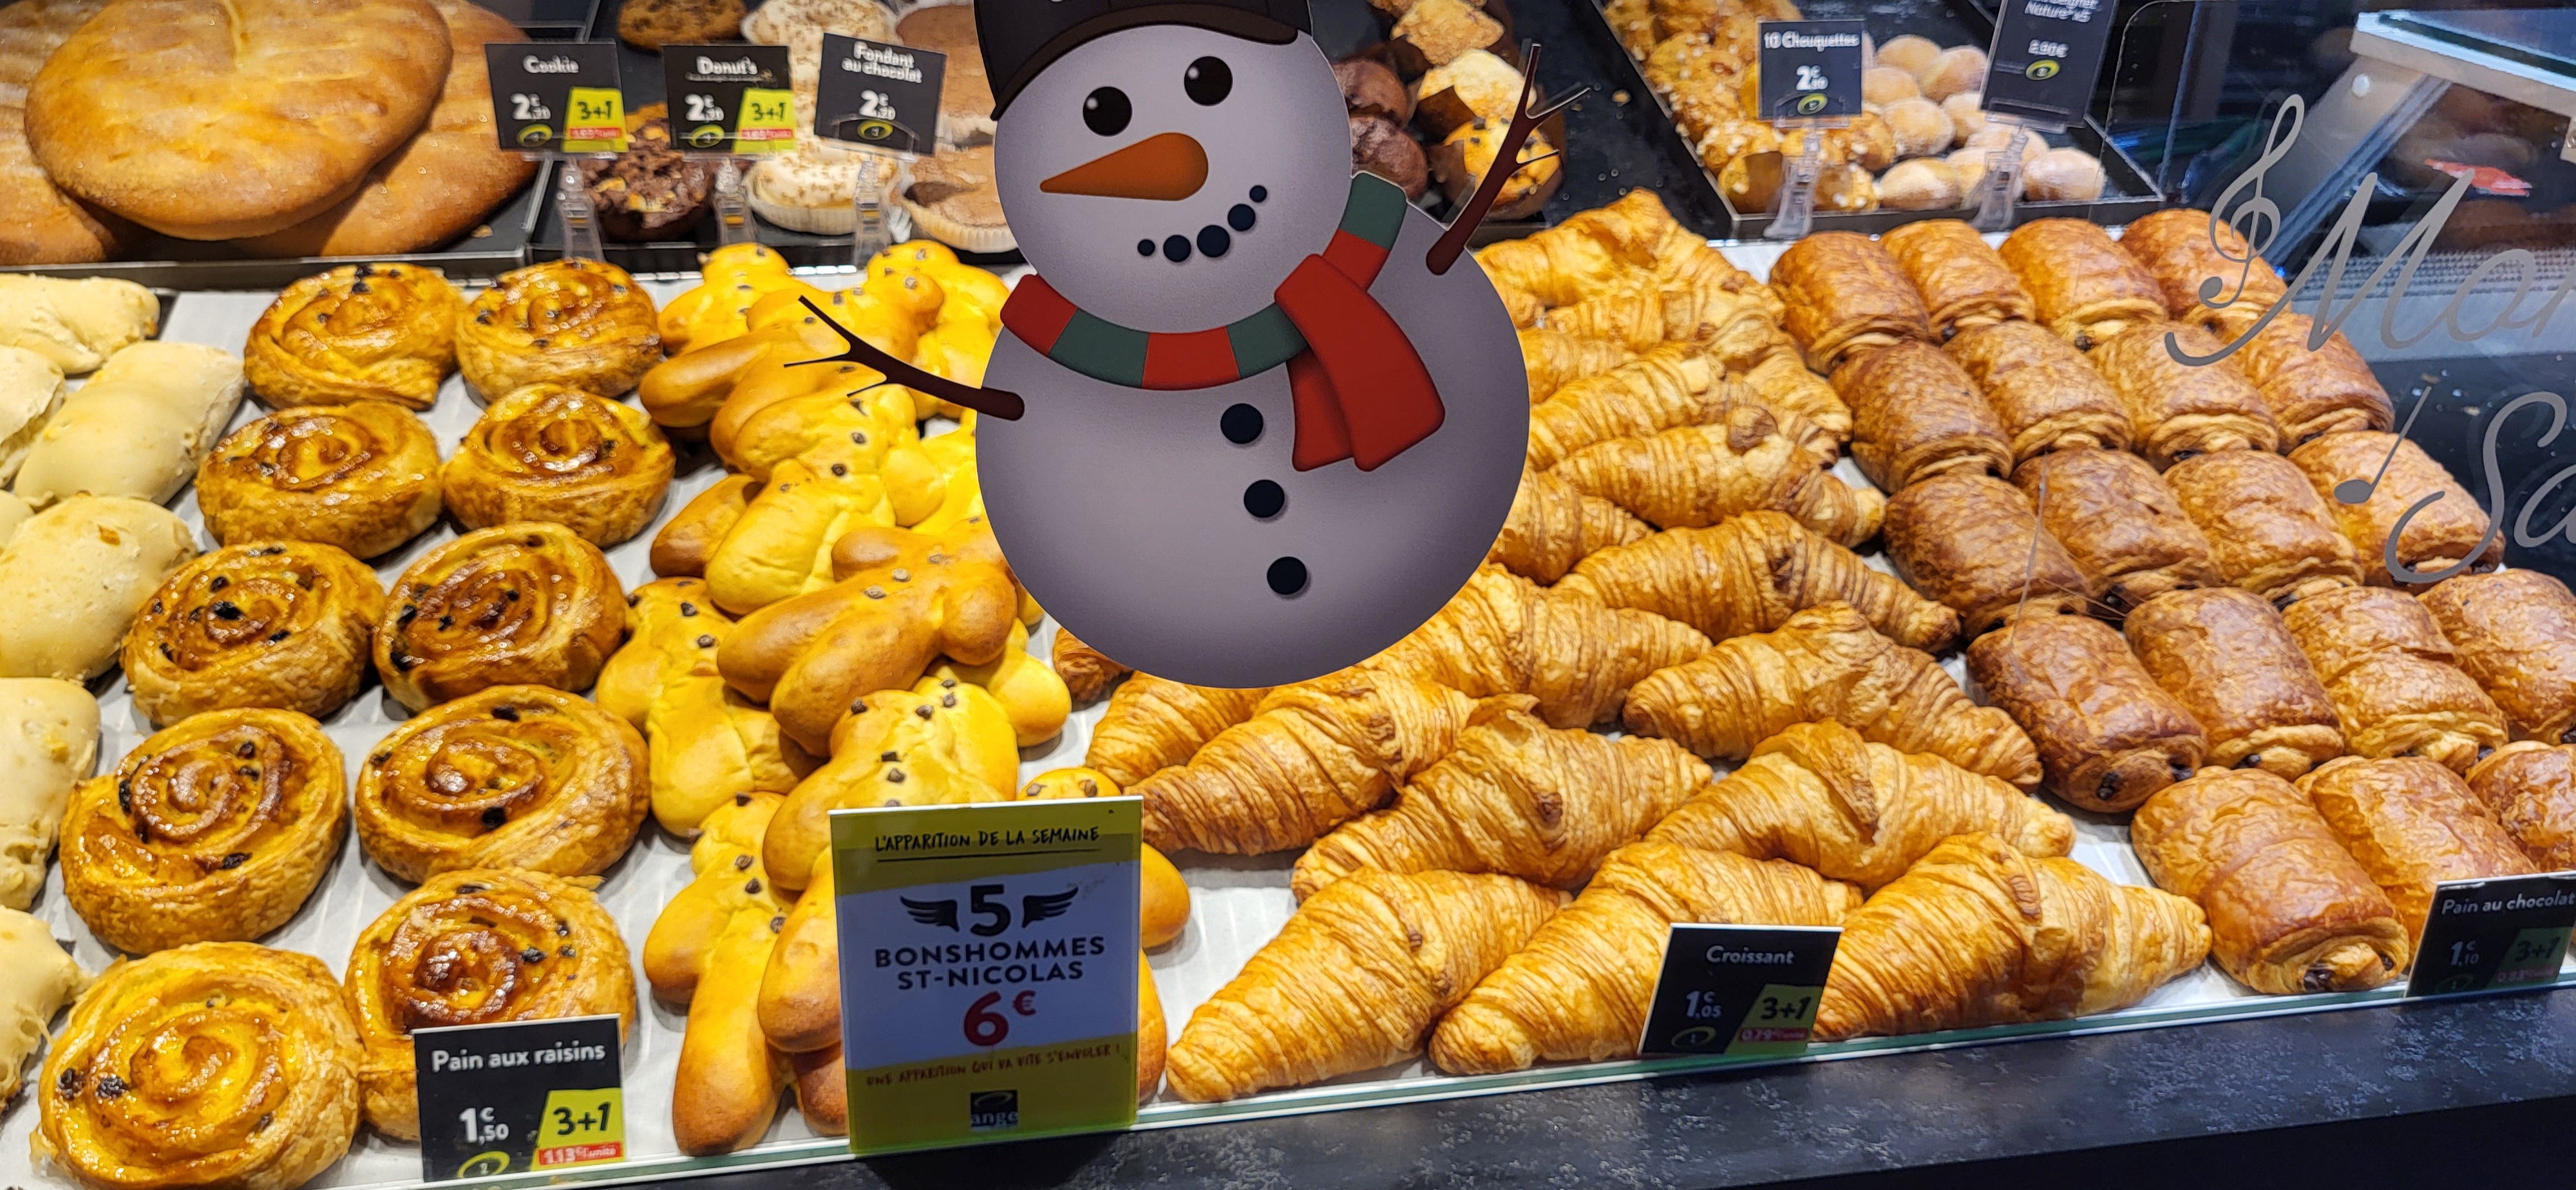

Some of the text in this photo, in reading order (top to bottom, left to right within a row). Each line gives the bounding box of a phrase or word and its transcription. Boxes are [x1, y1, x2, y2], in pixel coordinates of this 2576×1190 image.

[2025, 1, 2070, 20] Nature
[853, 41, 914, 68] Fondant
[1764, 31, 1860, 52] 10 Chouquettes
[523, 55, 579, 73] Cookie
[696, 55, 758, 75] Donut's
[841, 57, 923, 84] au chocolat
[2164, 169, 2576, 367] Mo
[875, 826, 1101, 853] L'APPARITION DE LA SEMAINE
[970, 884, 1012, 936] 5
[2441, 889, 2576, 915] Pain au chocolat
[875, 936, 1105, 968] BONSHOMMES
[1706, 945, 1795, 965] Croissant
[897, 961, 1084, 990] ST-NICOLAS
[431, 1039, 606, 1073] Pain aux raisins
[867, 1075, 893, 1086] UNE
[899, 1064, 967, 1084] APPARITION
[972, 1060, 994, 1075] QUI
[998, 1059, 1014, 1070] VA
[1018, 1052, 1042, 1068] VITE
[553, 1101, 612, 1135] 3+1
[971, 1110, 1019, 1128] ange
